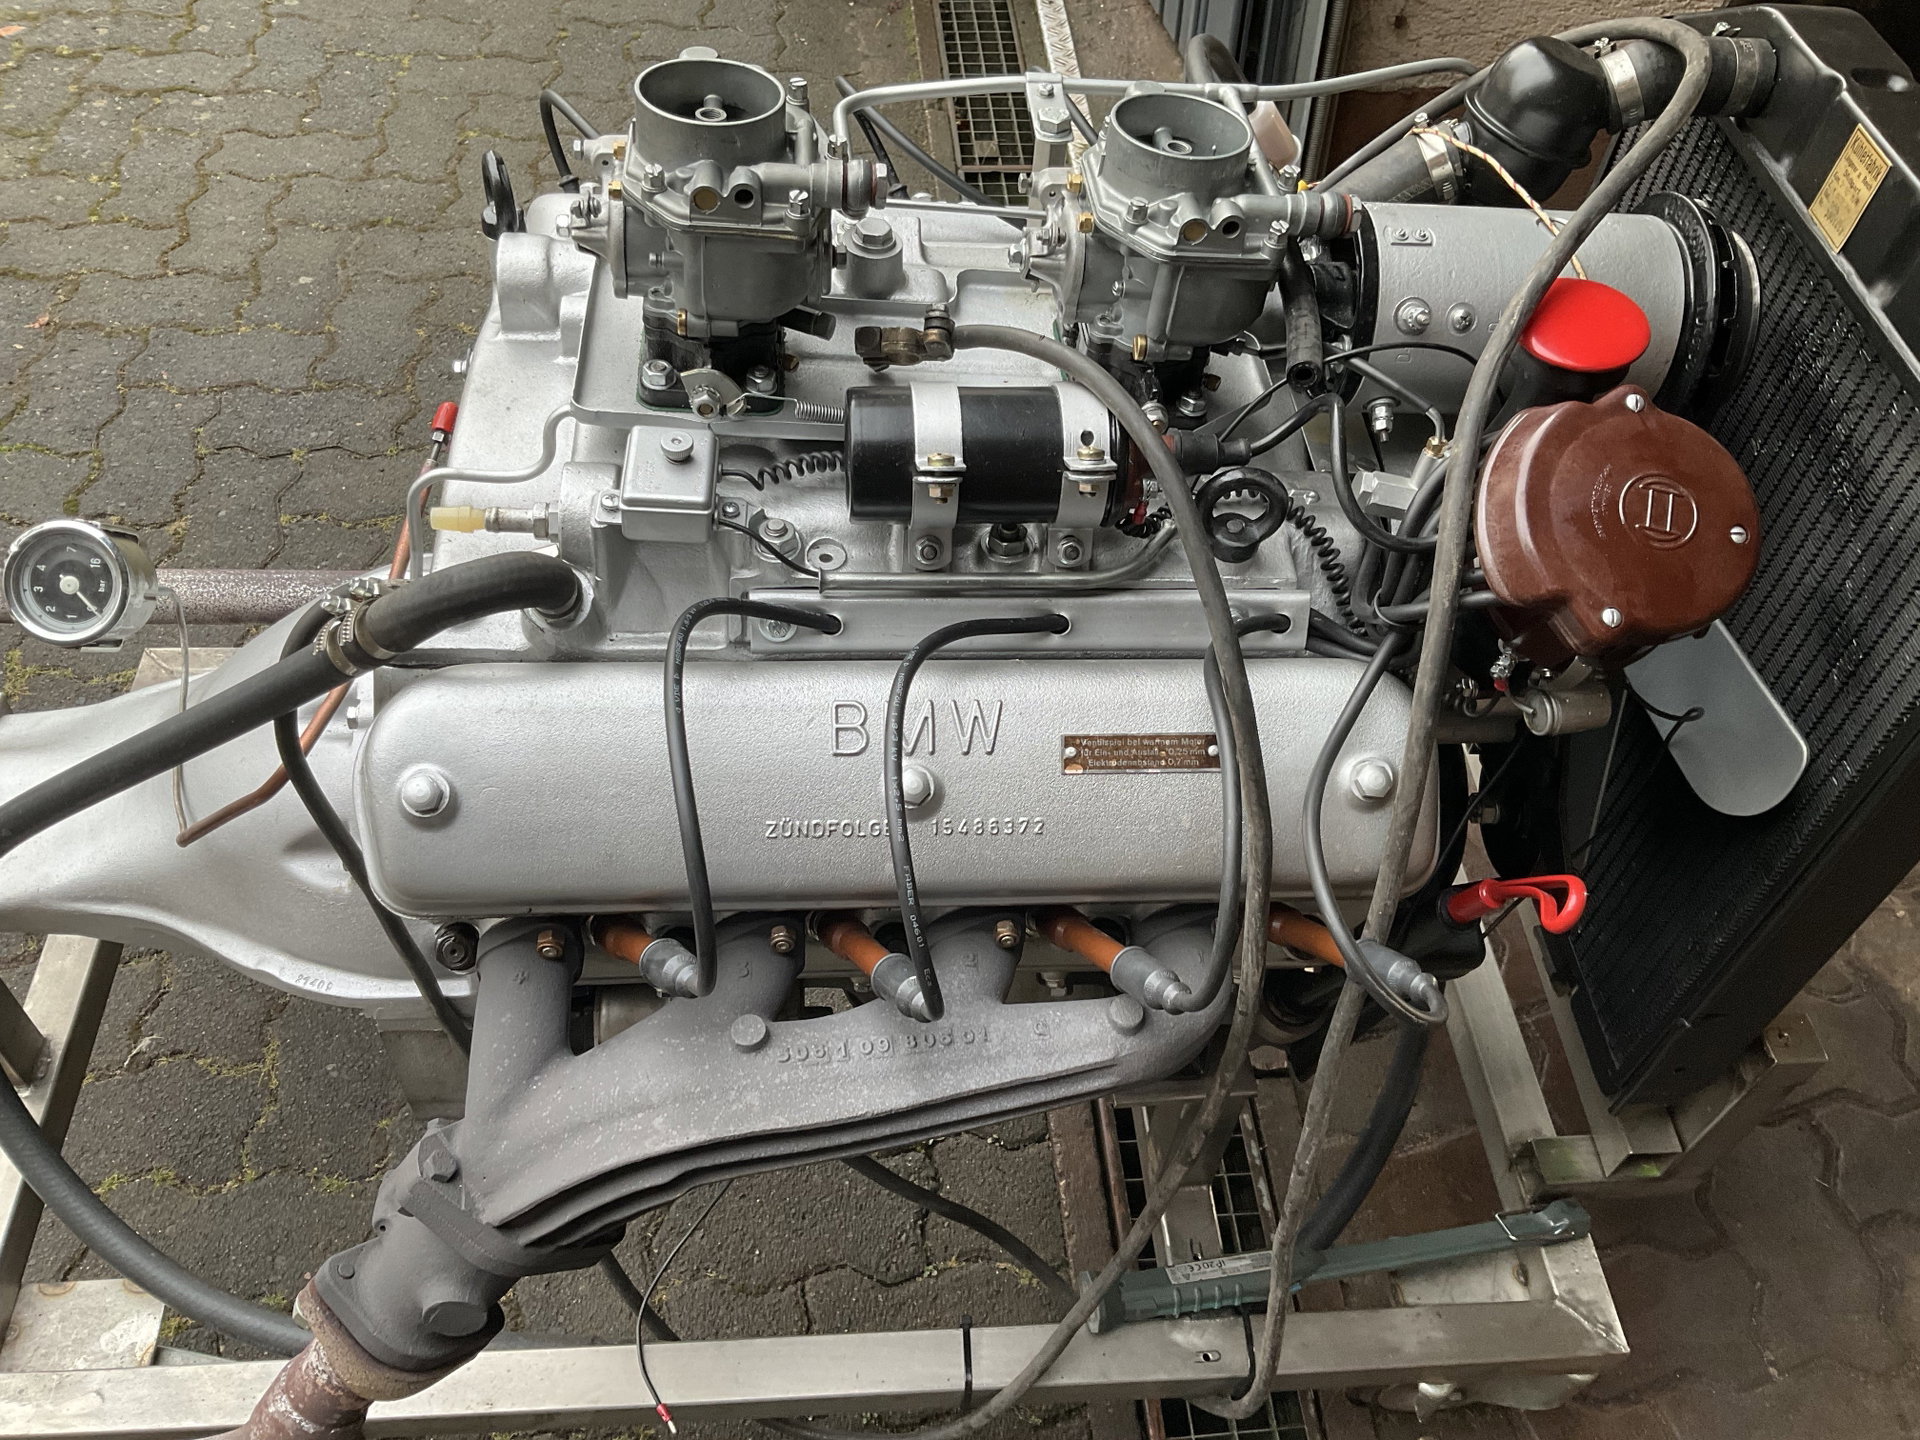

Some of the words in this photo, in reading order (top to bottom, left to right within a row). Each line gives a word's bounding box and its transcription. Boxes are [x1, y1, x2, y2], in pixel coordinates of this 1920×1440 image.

[1850, 135, 1883, 182] Kühlerfabrik
[36, 564, 47, 572] 4
[90, 557, 101, 568] 16
[98, 580, 107, 593] bar
[45, 605, 56, 613] 2
[831, 698, 1003, 756] BMW
[1113, 748, 1129, 756] und
[1190, 748, 1206, 756] mm
[1182, 758, 1199, 766] mm
[931, 816, 1045, 836] 15486372
[903, 865, 915, 906] FABER
[909, 914, 925, 948] 04601
